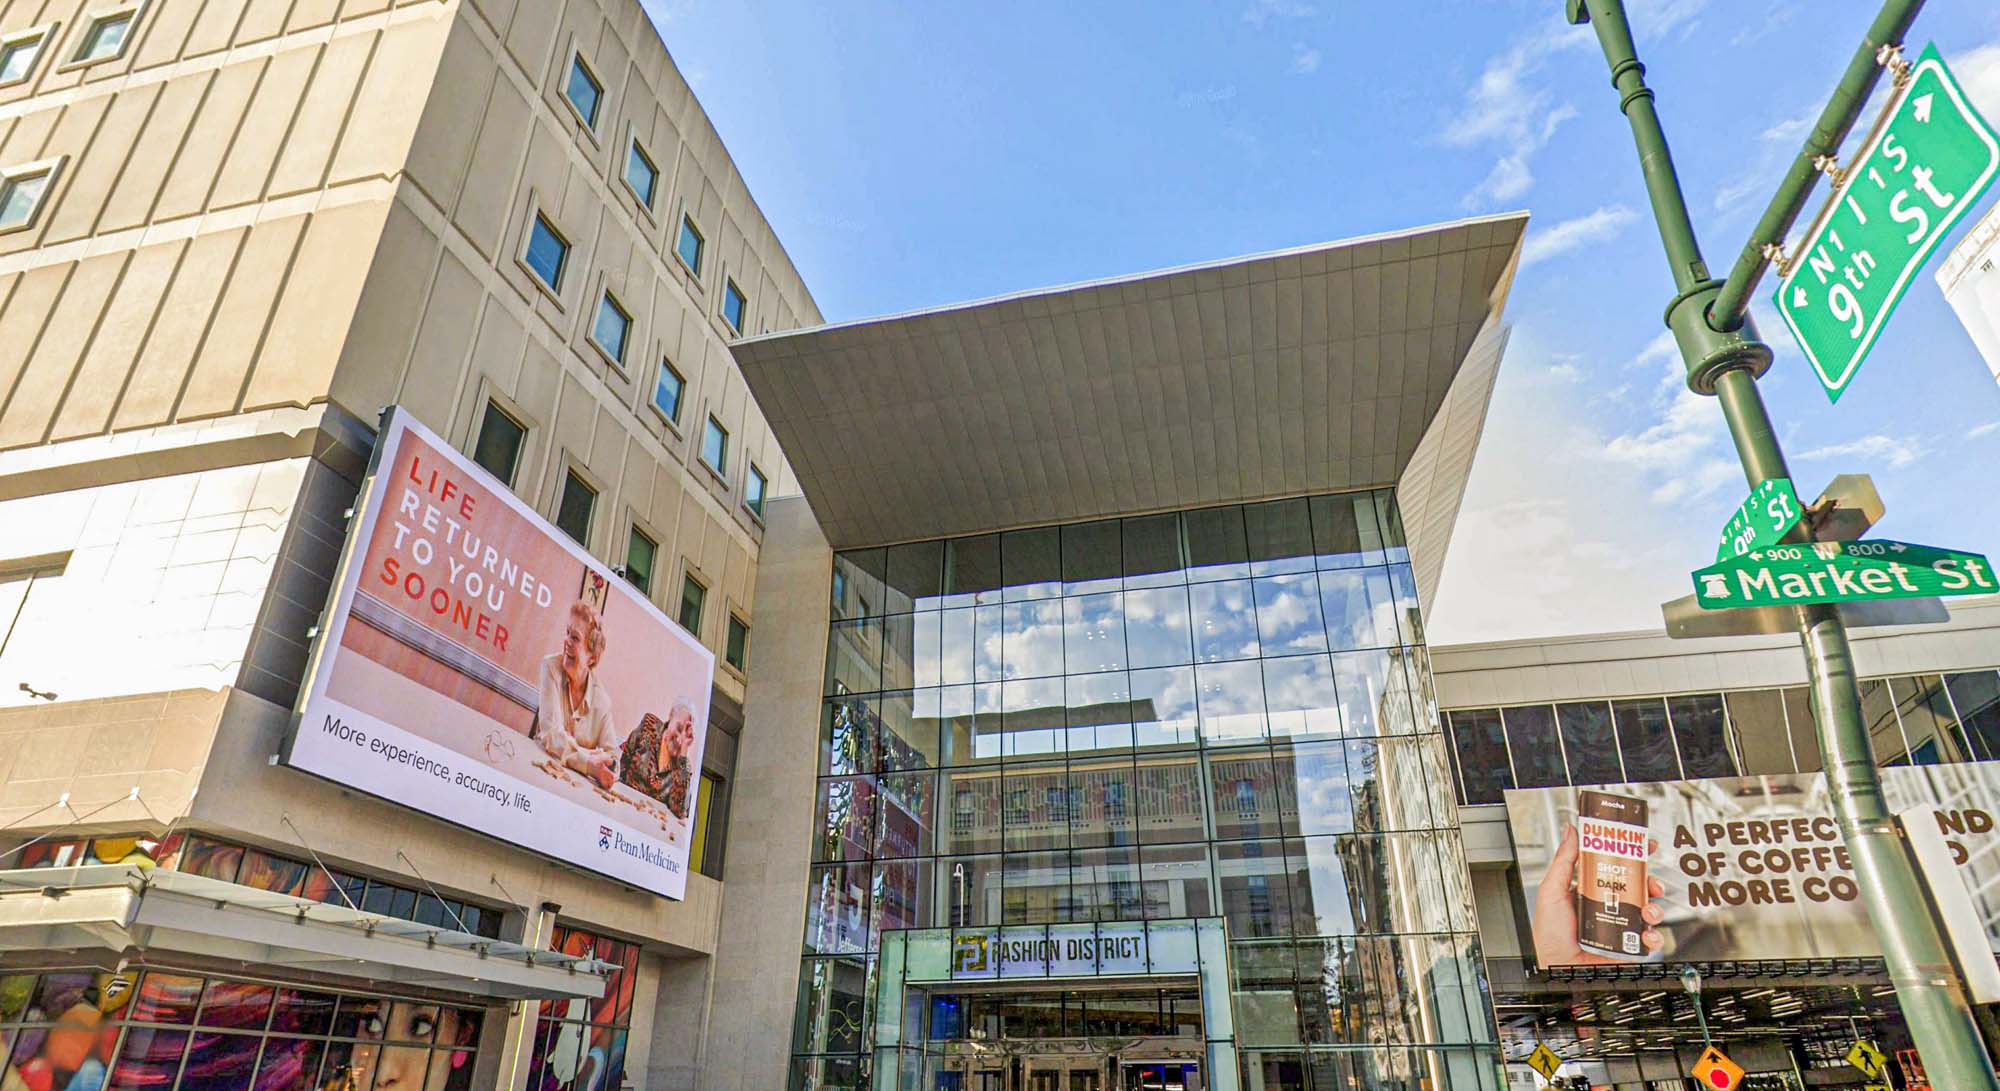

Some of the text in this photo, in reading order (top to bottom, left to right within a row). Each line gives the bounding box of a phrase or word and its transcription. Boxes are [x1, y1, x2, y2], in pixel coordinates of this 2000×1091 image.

[1827, 164, 1955, 339] 9th St
[409, 456, 476, 520] LIFE
[1767, 491, 1794, 531] St
[400, 488, 552, 608] RETURNED
[1766, 543, 1886, 561] 900 W 800
[393, 521, 504, 612] TO YOU
[1736, 558, 1993, 600] Market St
[379, 557, 509, 652] SOONER
[322, 714, 534, 814] More experience, accuracy, life.
[1600, 800, 1625, 810] Mocha
[1583, 822, 1646, 844] DUNKIN'
[1583, 836, 1644, 858] DONUTS
[1673, 824, 1697, 849] A
[1704, 816, 1841, 847] PERFEC
[614, 831, 680, 873] Penn Medicine
[1596, 862, 1627, 875] SHOT
[1679, 845, 1852, 877] OF COFFE
[1596, 879, 1627, 893] DARK
[1688, 875, 1858, 907] MORE CO
[992, 936, 1141, 963] FASHION DISTRICT
